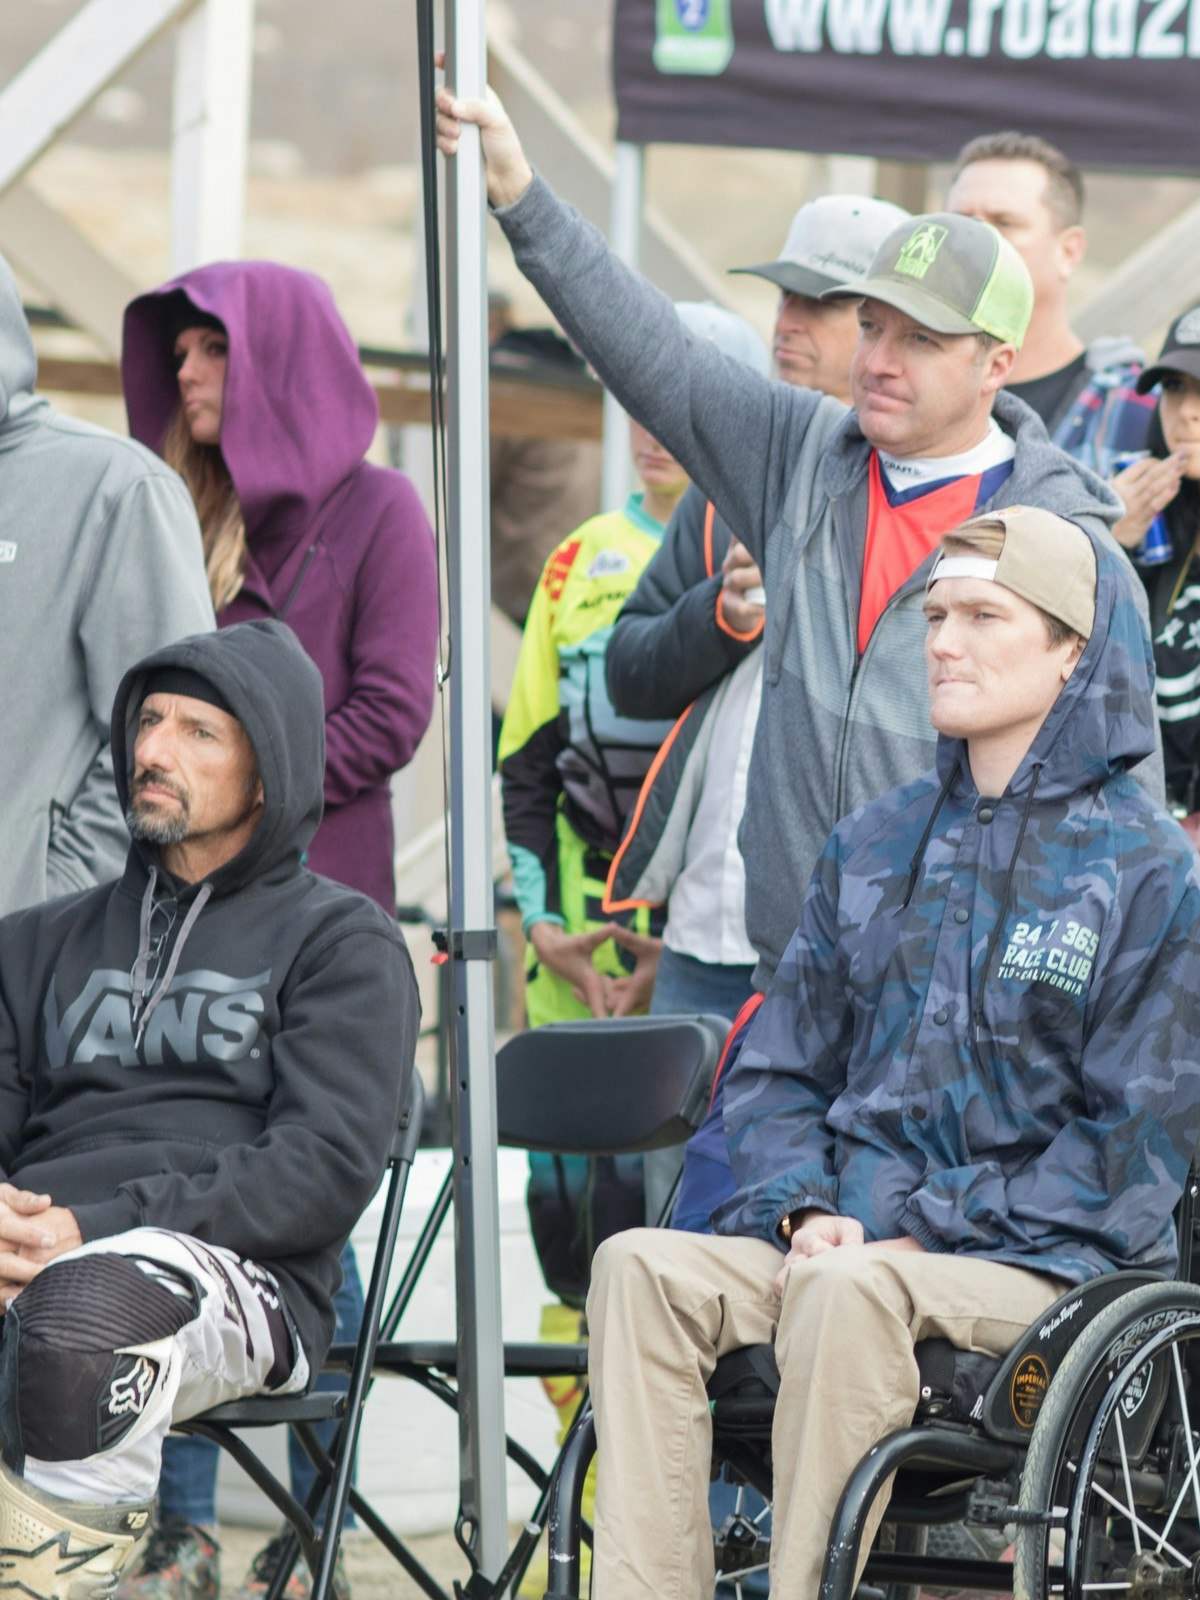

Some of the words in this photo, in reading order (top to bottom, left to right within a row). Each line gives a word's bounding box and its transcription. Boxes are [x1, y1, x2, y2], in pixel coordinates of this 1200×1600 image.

[1012, 922, 1043, 946] 24
[1061, 920, 1100, 958] 365
[1002, 944, 1046, 968] RACE
[1046, 947, 1092, 981] CLUB
[1020, 968, 1083, 997] CALIFORNIA
[43, 966, 272, 1070] VANS
